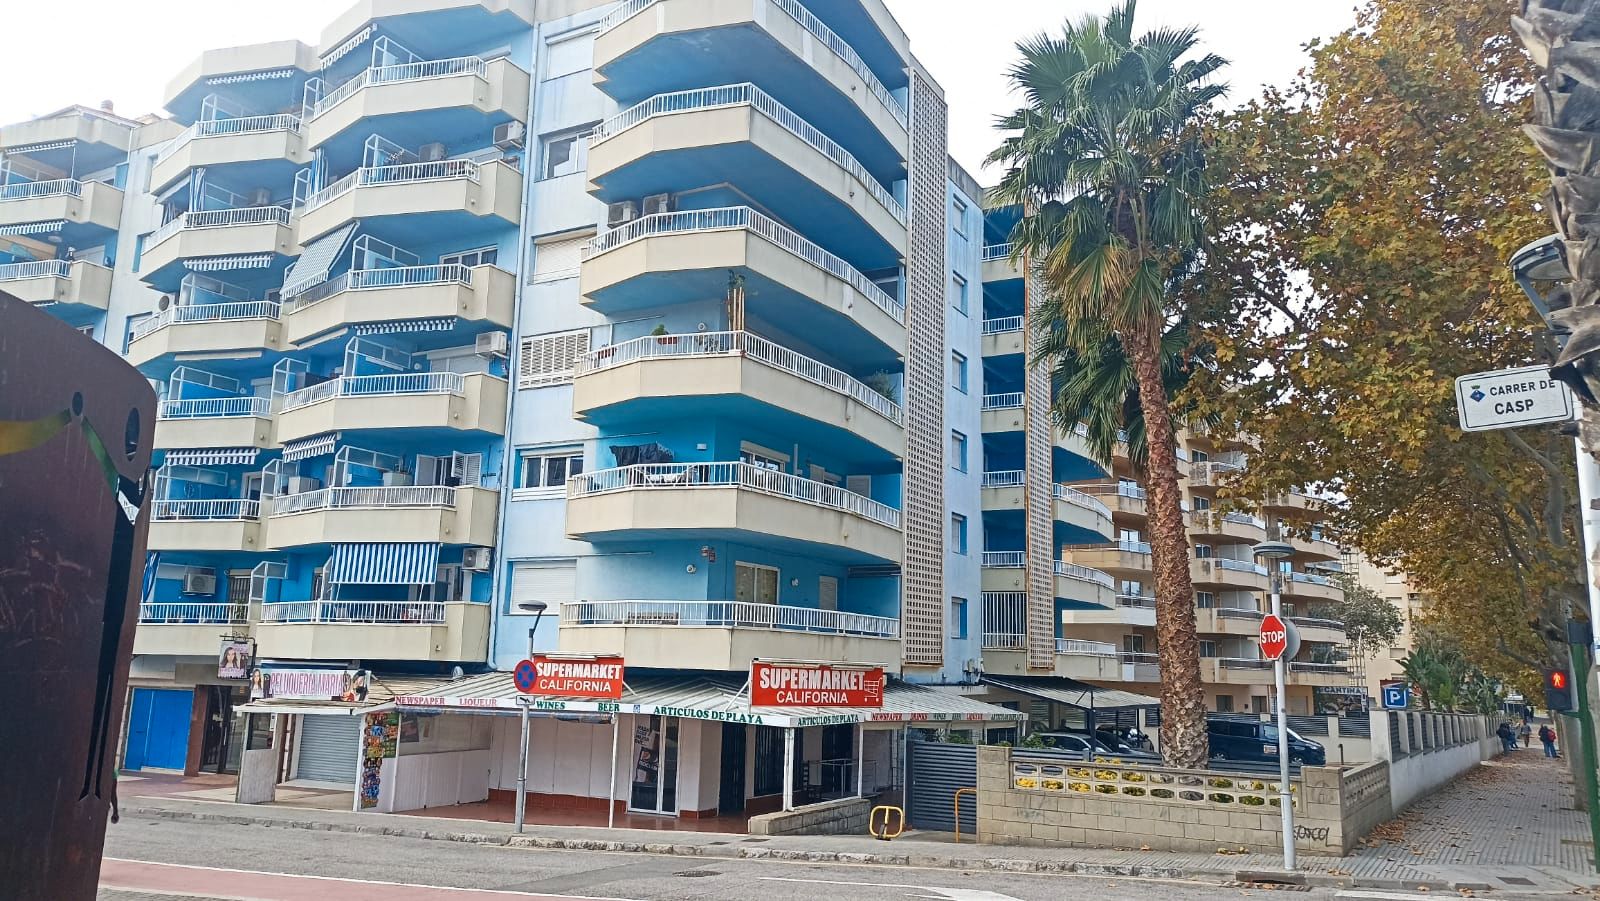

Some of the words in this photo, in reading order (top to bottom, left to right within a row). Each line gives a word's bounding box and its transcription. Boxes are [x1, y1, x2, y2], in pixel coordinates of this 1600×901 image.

[1490, 382, 1535, 394] CARRER
[1539, 380, 1555, 389] DE
[1495, 399, 1533, 414] CASP
[1261, 631, 1284, 644] STOP
[536, 662, 622, 680] SUPERMARKET
[539, 679, 612, 693] CALIFORNIA
[760, 668, 865, 690] SUPERMARKET
[395, 696, 445, 706] NEWSPAPER
[459, 698, 497, 707] LIQUEUR
[776, 691, 848, 703] CALIFORNIA
[1390, 690, 1401, 704] P
[536, 700, 565, 710] WINES
[598, 702, 620, 712] BEER
[654, 706, 710, 720] ARTICULOS
[711, 711, 725, 721] DE
[726, 712, 763, 725] PLAYA
[797, 715, 832, 727] ARTICULOS
[840, 714, 859, 724] PLAYA
